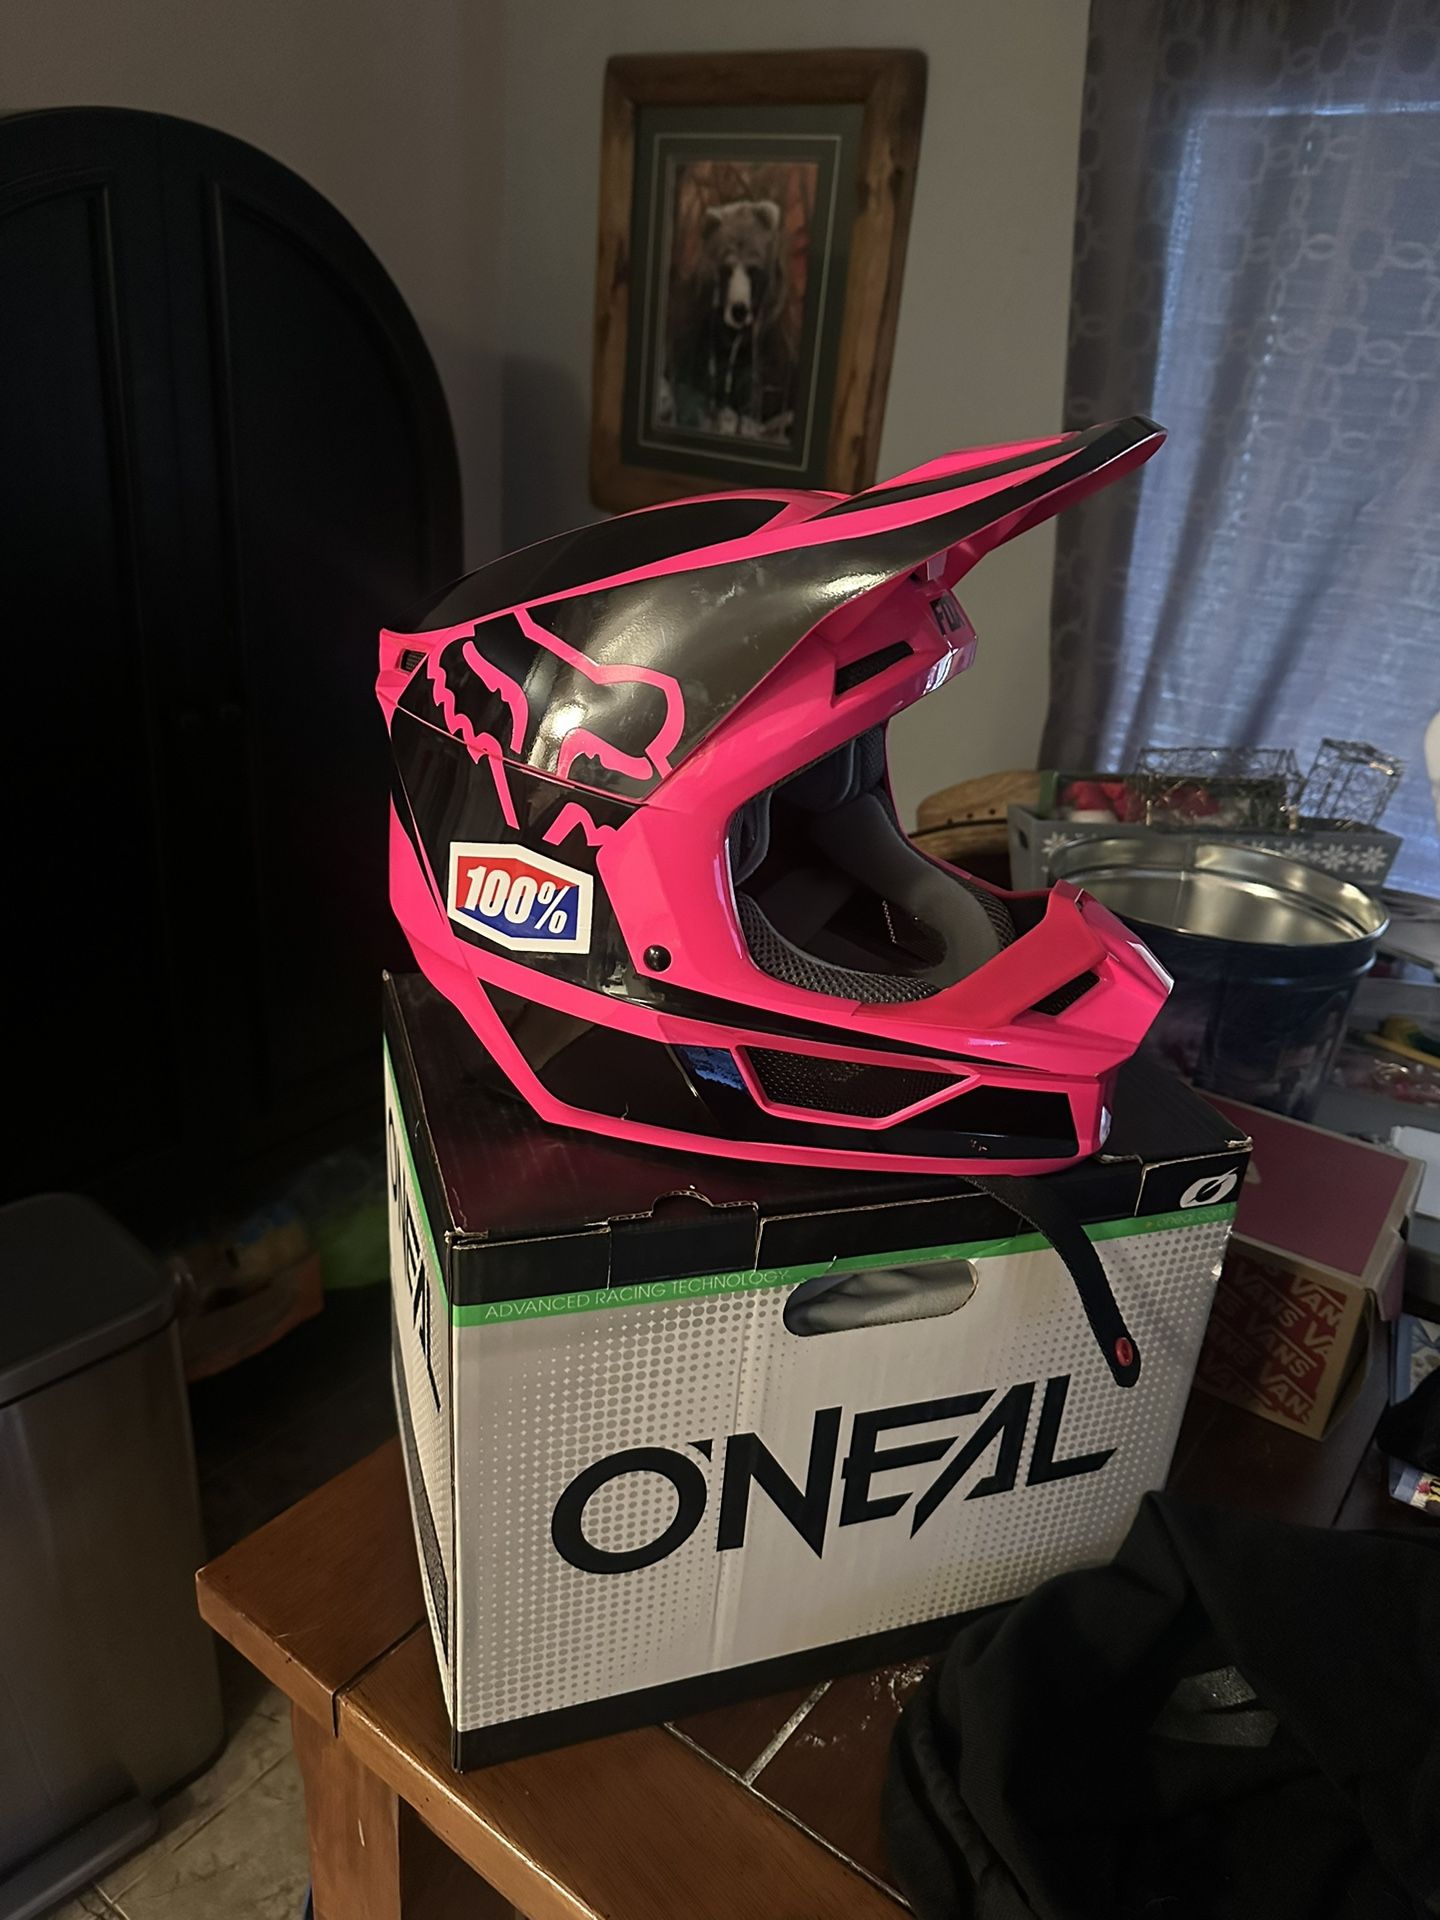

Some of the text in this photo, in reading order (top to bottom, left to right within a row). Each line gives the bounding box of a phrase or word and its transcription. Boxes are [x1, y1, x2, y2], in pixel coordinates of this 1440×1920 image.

[930, 595, 963, 634] FO
[465, 866, 568, 934] 100%
[484, 1270, 790, 1320] ADVANCED RACING TECHNOLOGY
[1289, 1276, 1344, 1326] VAN
[1246, 1312, 1318, 1378] VANS
